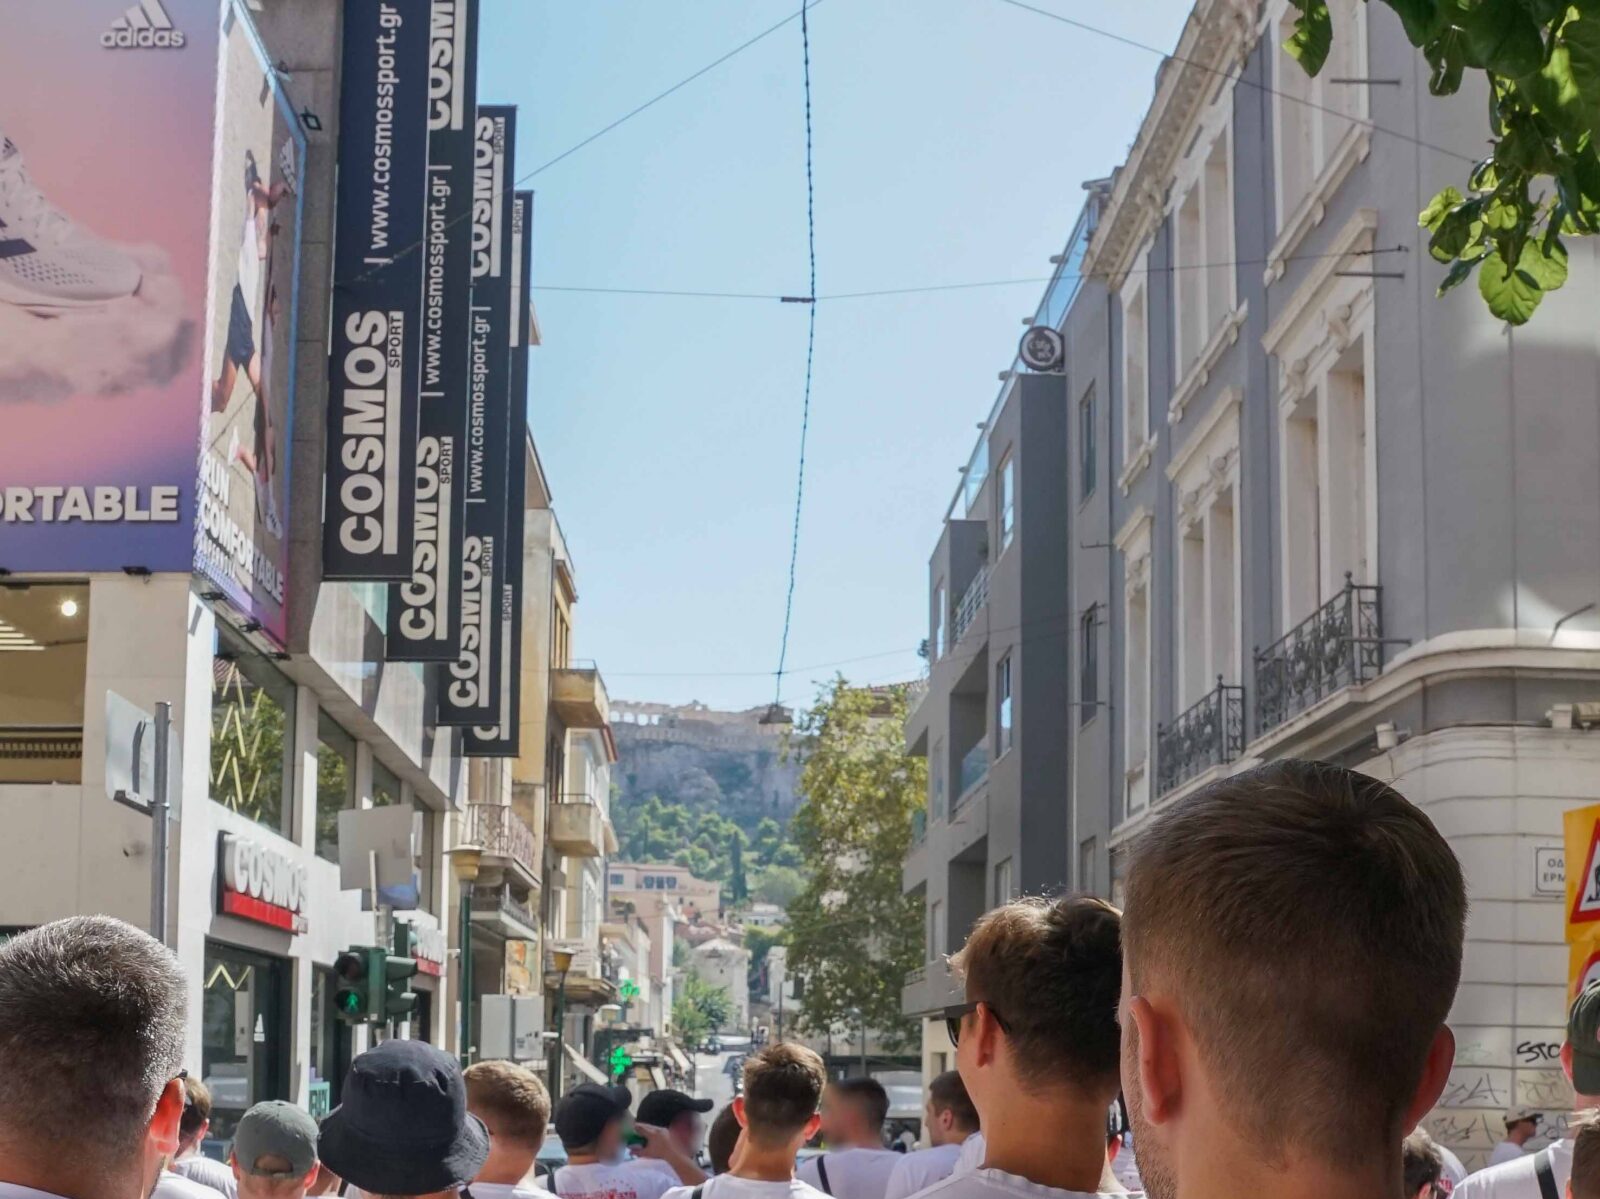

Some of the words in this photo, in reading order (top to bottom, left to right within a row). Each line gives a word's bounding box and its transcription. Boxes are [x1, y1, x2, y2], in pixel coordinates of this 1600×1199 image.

[101, 27, 184, 49] adidas
[429, 0, 455, 131] COSM
[370, 2, 403, 250] www.cosmossport.gr
[493, 119, 505, 155] SPORT
[471, 116, 495, 278] COSMOS
[512, 201, 523, 235] SPORT
[425, 175, 451, 385] www.cosmossport.gr
[388, 315, 402, 369] SPORT
[339, 309, 388, 555] COSMOS
[469, 315, 491, 492] www.cosmossport.gr
[440, 441, 452, 485] SPORT
[0, 486, 178, 521] RTABLE
[399, 435, 440, 641] COSMOS
[481, 540, 493, 577] SPORT
[448, 535, 482, 708] COSMOS
[501, 585, 513, 622] SPORT
[231, 840, 308, 911] COSMOS
